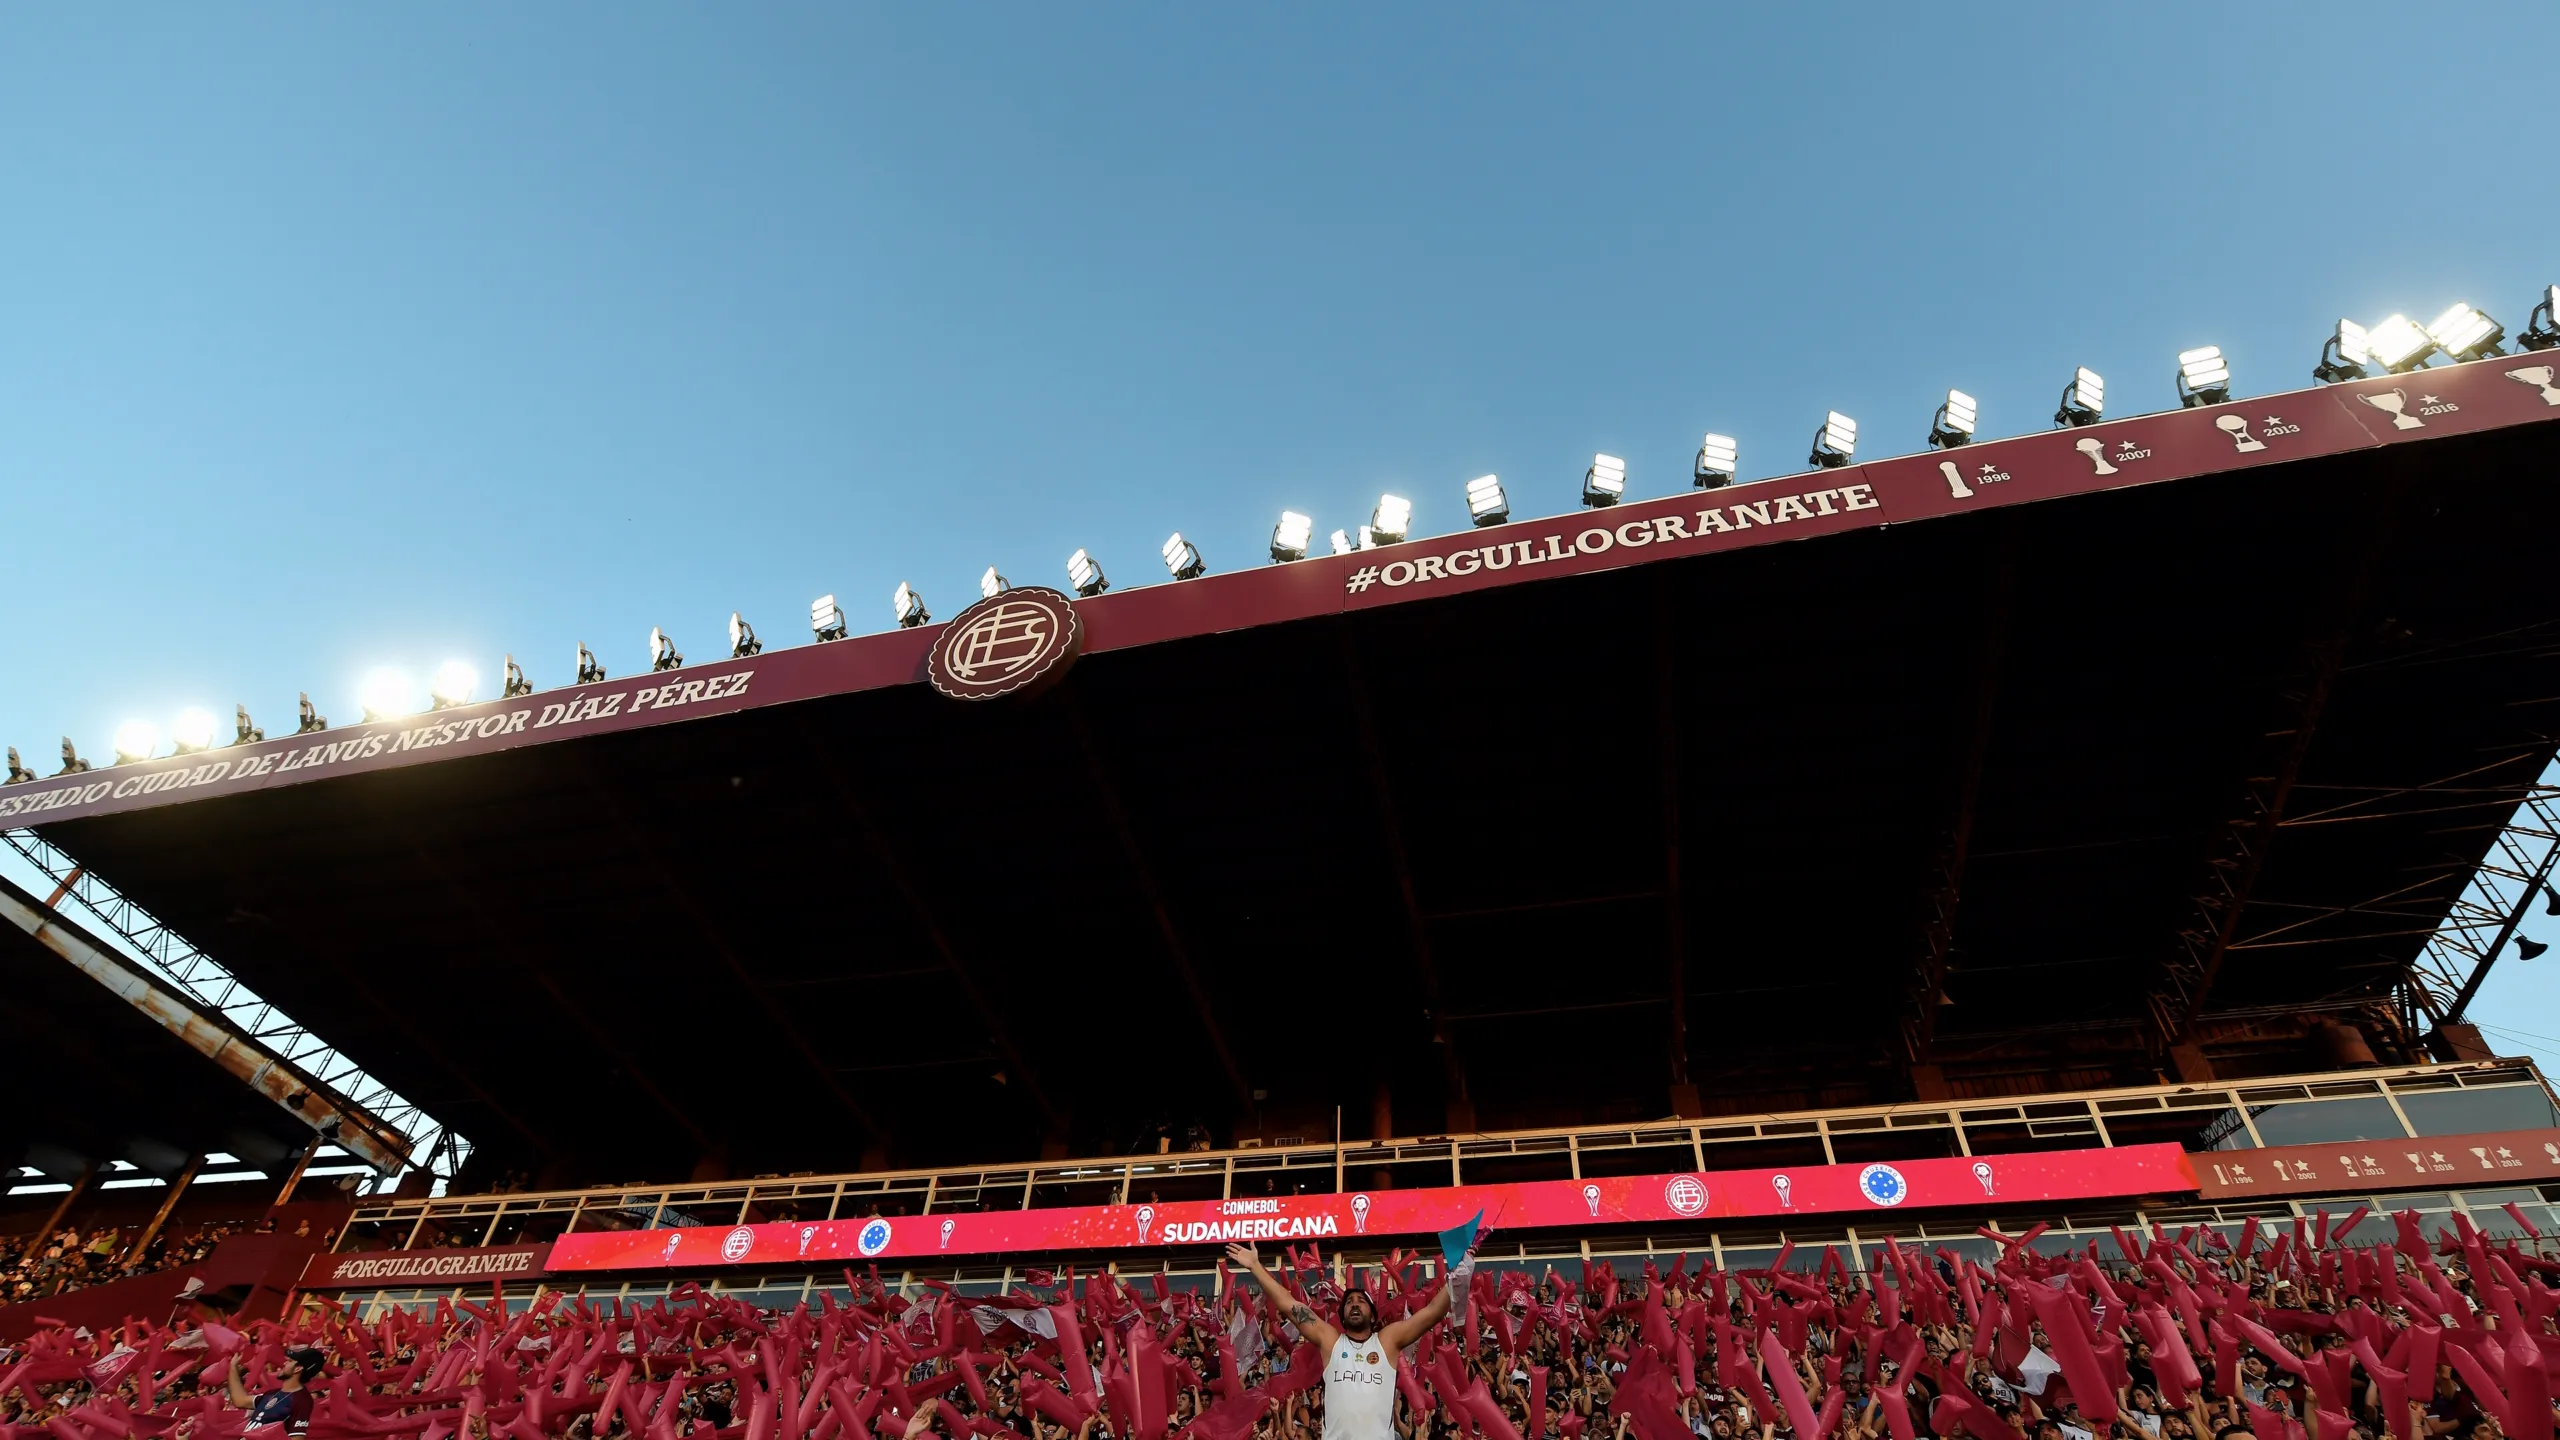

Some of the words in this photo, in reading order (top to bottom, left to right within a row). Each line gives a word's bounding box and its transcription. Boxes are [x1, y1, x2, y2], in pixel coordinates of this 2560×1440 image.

[2419, 403, 2460, 415] 2016
[2263, 424, 2301, 437] 2013
[2115, 449, 2151, 462] 2007
[1976, 472, 2011, 485] 1996
[1345, 483, 1880, 594] #ORGULLOGRANATE
[0, 781, 114, 817] ESTADIO
[112, 761, 230, 799] CIUDAD
[228, 752, 281, 781] DE
[277, 730, 389, 773] LANÚS
[387, 707, 532, 754] NÉSTOR
[533, 692, 628, 729] DÍAZ
[626, 670, 755, 713] PÉREZ
[2432, 1163, 2455, 1172] 2016
[2500, 1159, 2523, 1168] 2016
[2296, 1172, 2318, 1180] 2007
[2364, 1167, 2386, 1176] 2013
[2233, 1176, 2254, 1184] 1996
[1162, 1215, 1339, 1243] SUDAMERICANA
[331, 1252, 535, 1280] #ORGULLOGRANATE
[1333, 1370, 1384, 1385] LANUS
